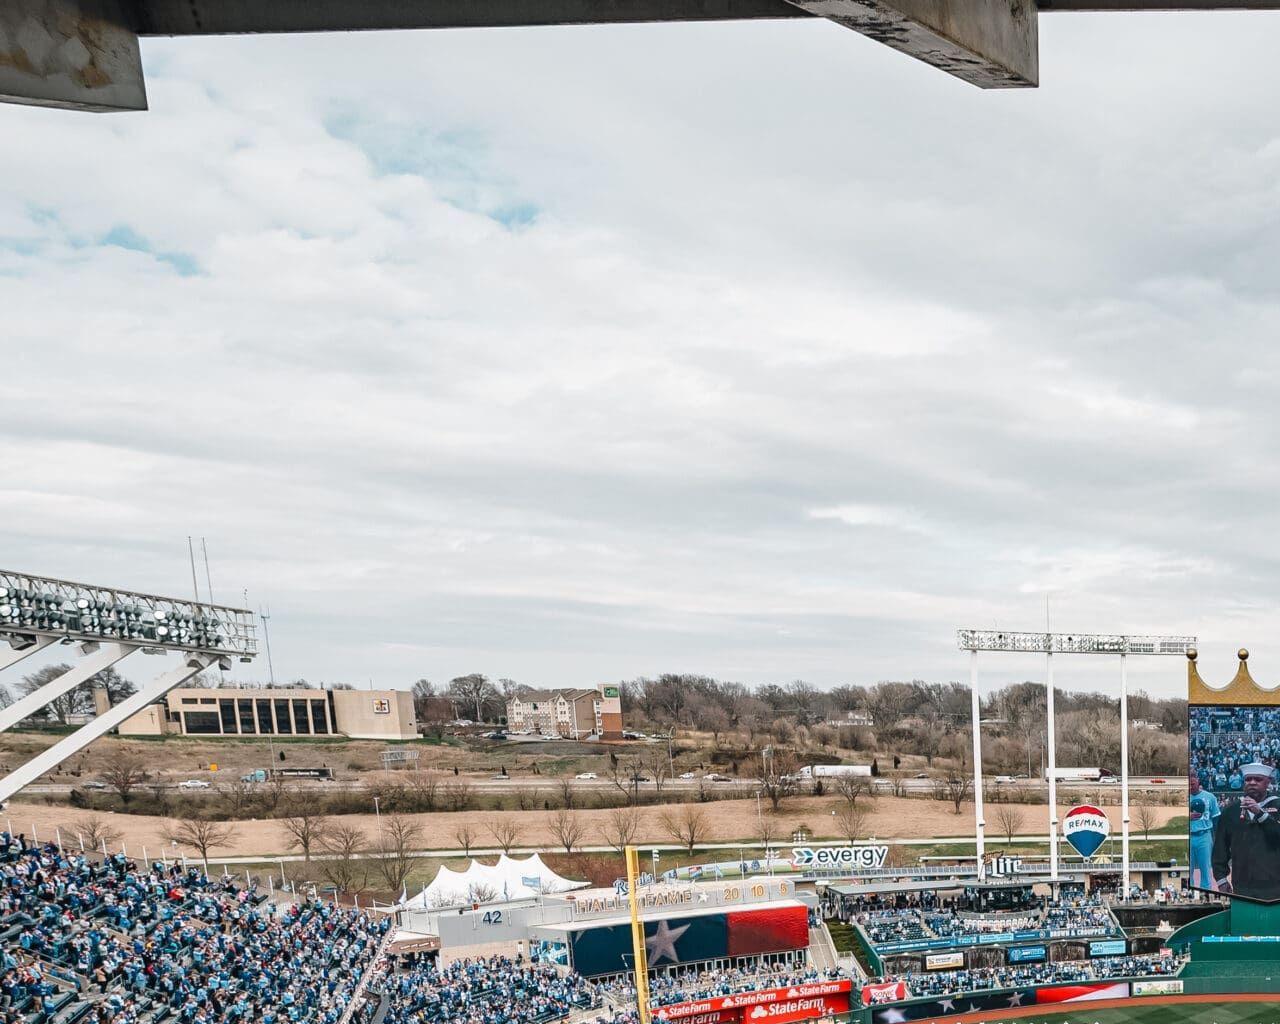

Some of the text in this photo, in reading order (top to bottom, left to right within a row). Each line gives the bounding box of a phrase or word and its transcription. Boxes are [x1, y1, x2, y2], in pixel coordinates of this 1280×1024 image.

[1068, 818, 1104, 829] RE/MAX
[817, 848, 888, 867] evergy
[723, 888, 739, 900] 20
[751, 884, 765, 897] 10
[780, 881, 788, 896] 5
[576, 896, 624, 914] HALL
[645, 889, 692, 907] FAME
[482, 911, 502, 925] 42
